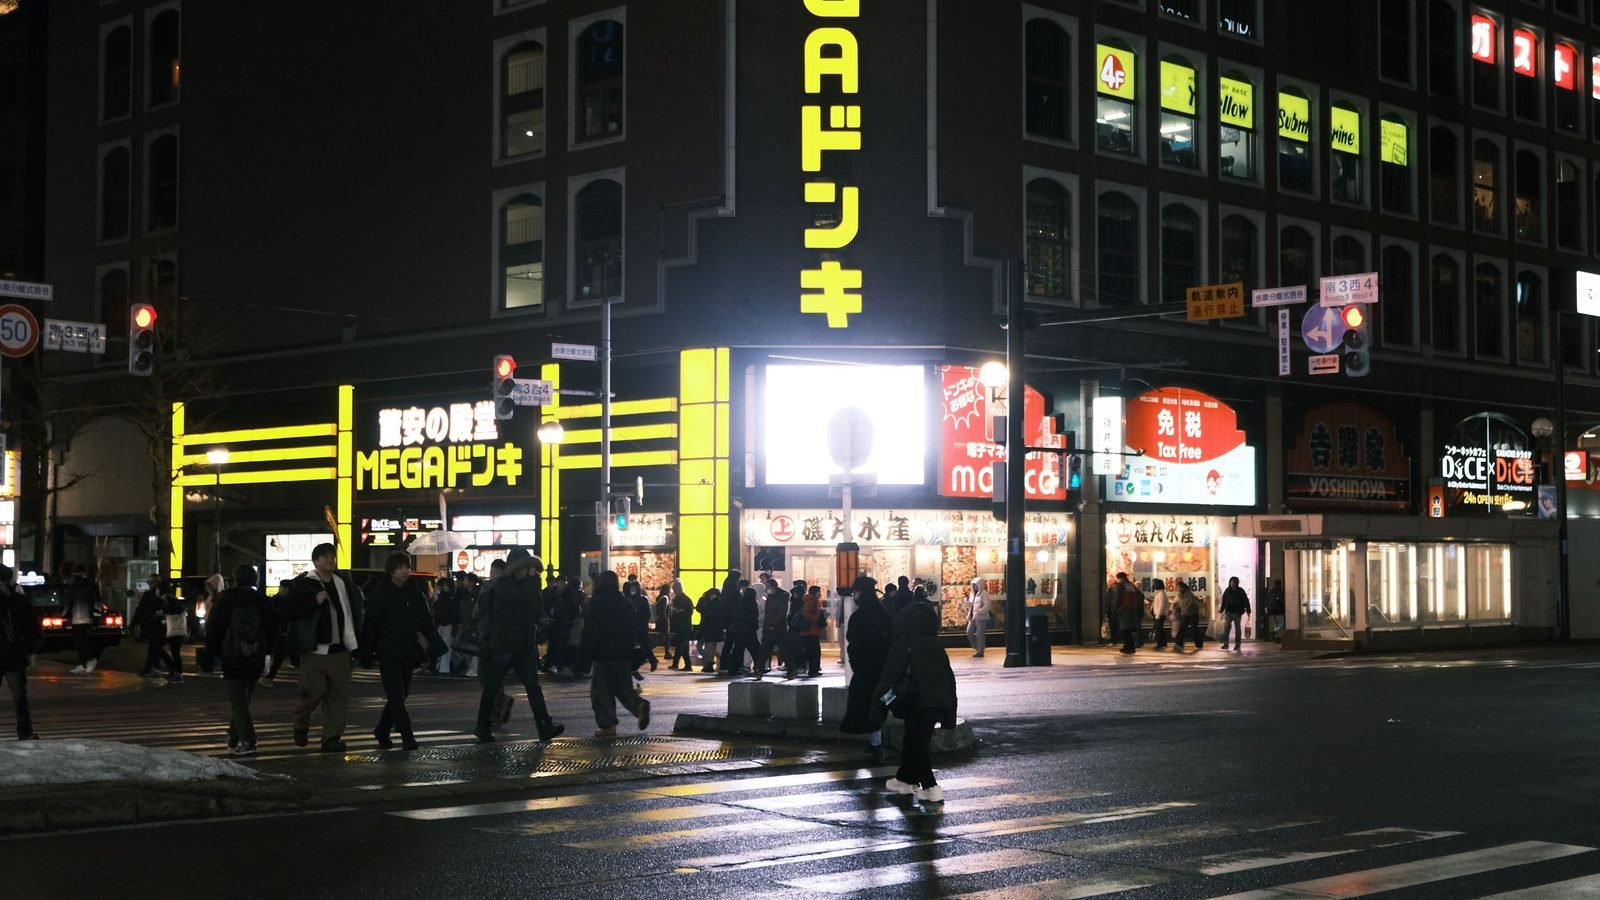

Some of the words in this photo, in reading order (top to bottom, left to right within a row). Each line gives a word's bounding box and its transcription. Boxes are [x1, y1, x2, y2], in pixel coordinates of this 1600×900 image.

[1101, 55, 1125, 90] 4F
[1232, 87, 1248, 96] BASE
[1220, 95, 1249, 119] llow
[800, 0, 862, 328] Aドンキ
[1191, 286, 1239, 302] 軌道敷内
[1324, 277, 1373, 294] 南3西4
[1191, 303, 1239, 317] 通行禁止
[0, 318, 28, 342] 50
[1157, 408, 1202, 438] 免税
[1158, 441, 1177, 458] Tax
[1180, 442, 1202, 460] Free
[1310, 422, 1385, 472] 吉野家
[356, 442, 523, 491] MEGAドンキ
[1463, 491, 1477, 505] 24h
[1477, 494, 1494, 505] OPEN
[1134, 520, 1195, 544] 磯丸水産
